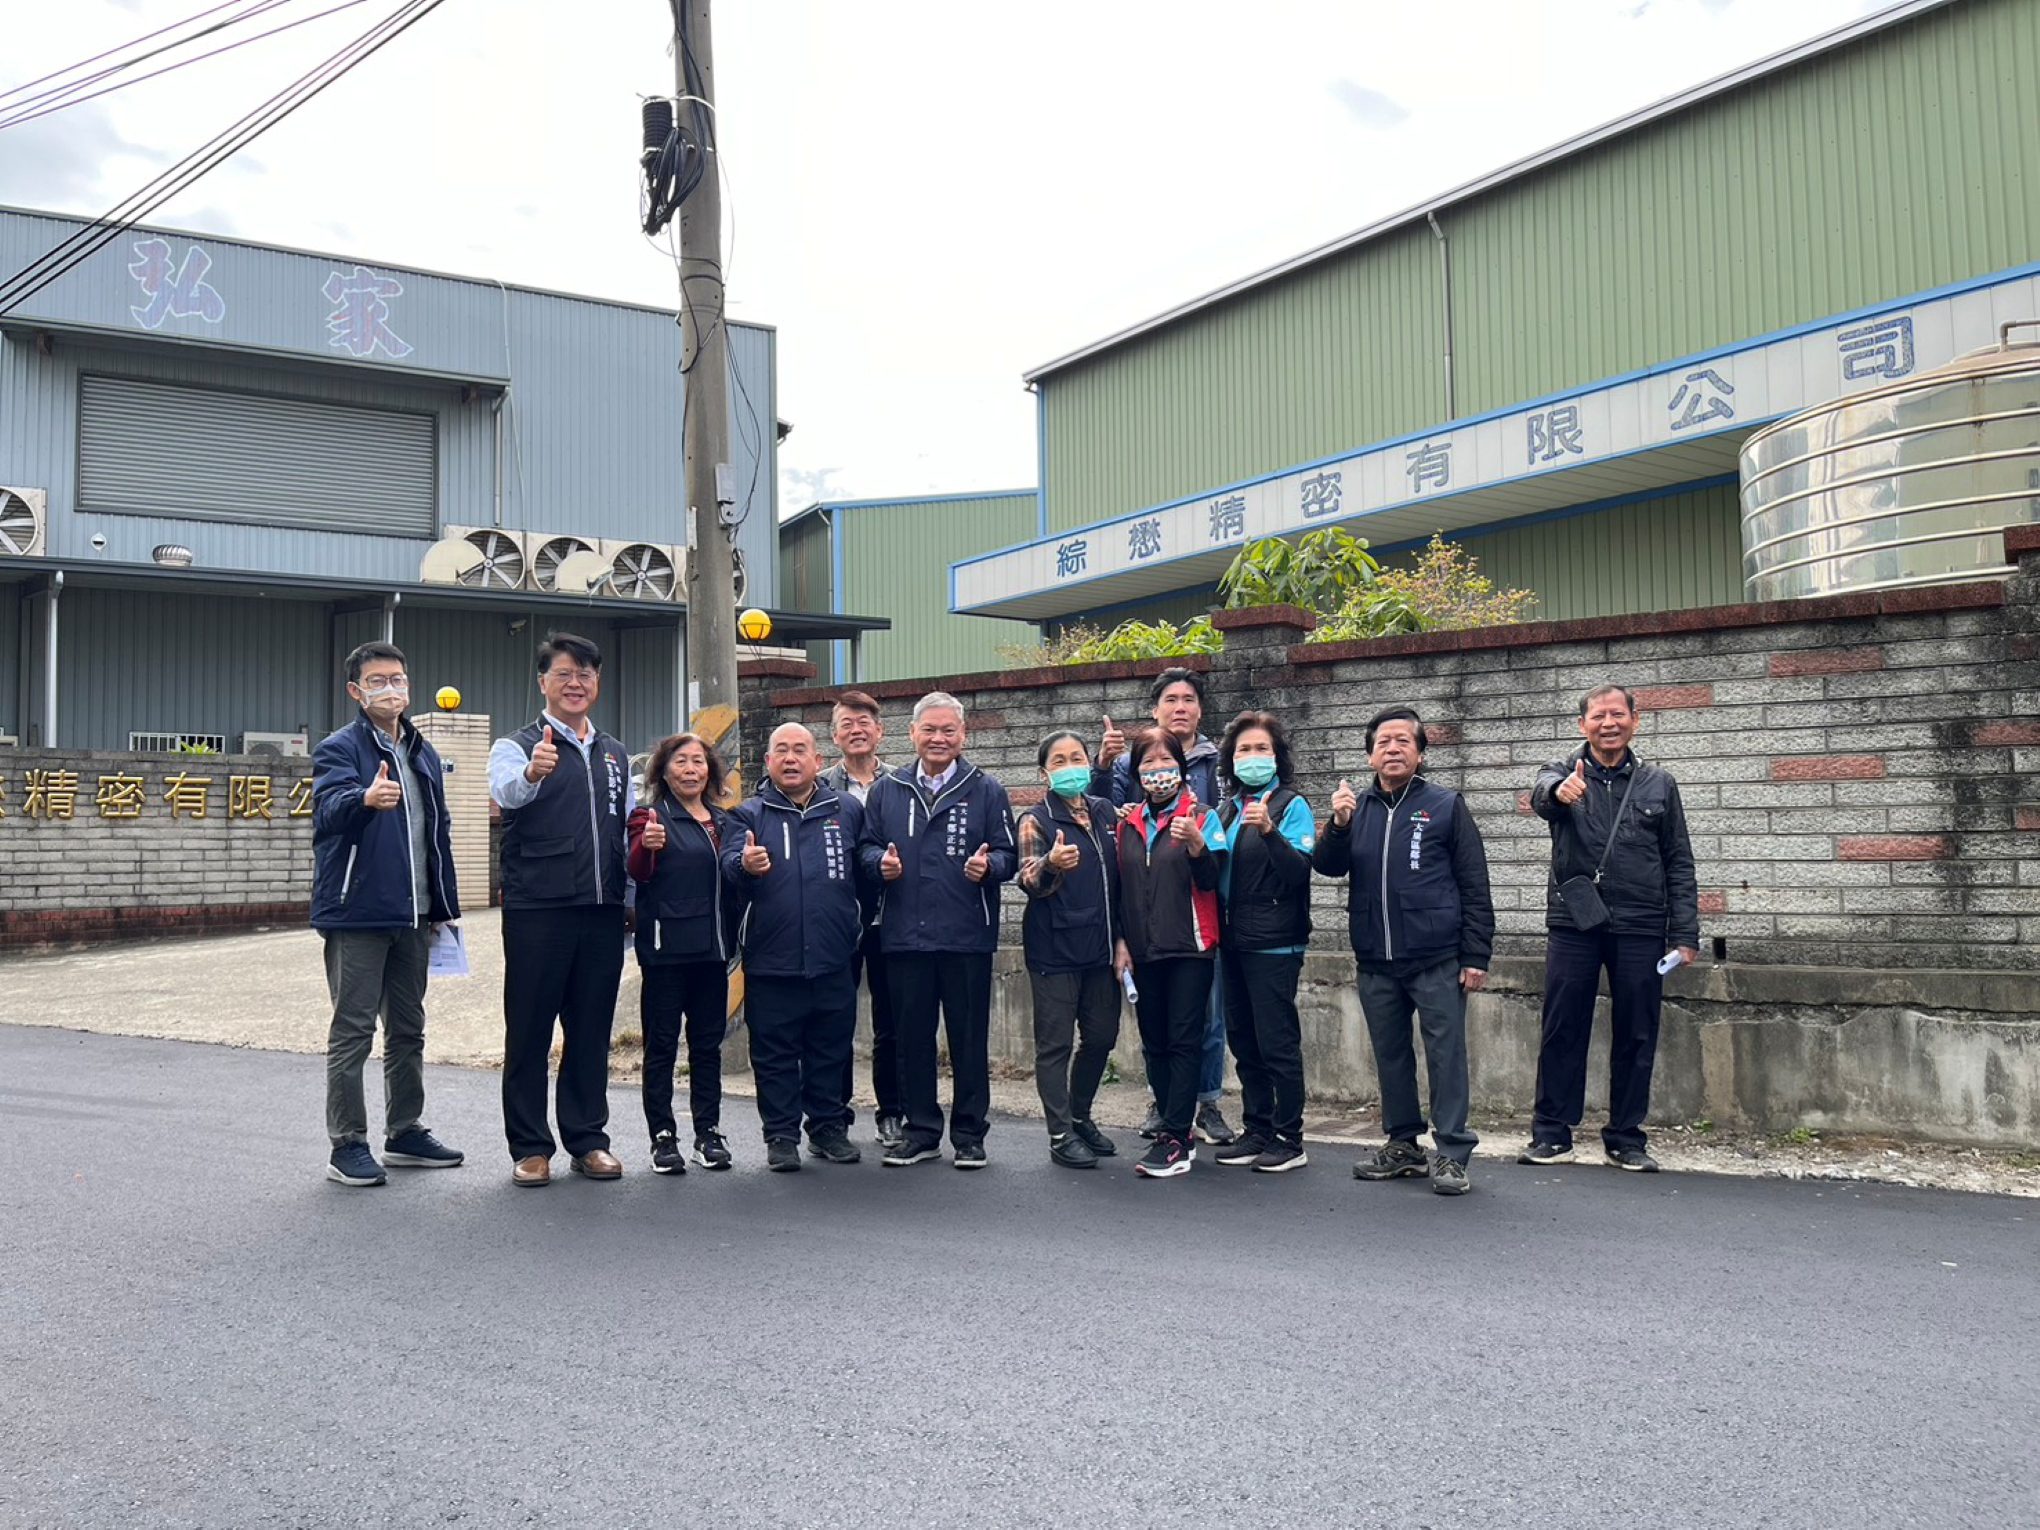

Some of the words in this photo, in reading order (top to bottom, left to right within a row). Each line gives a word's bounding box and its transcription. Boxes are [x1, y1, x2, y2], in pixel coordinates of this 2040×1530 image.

[0, 768, 313, 819] 精密有限公
